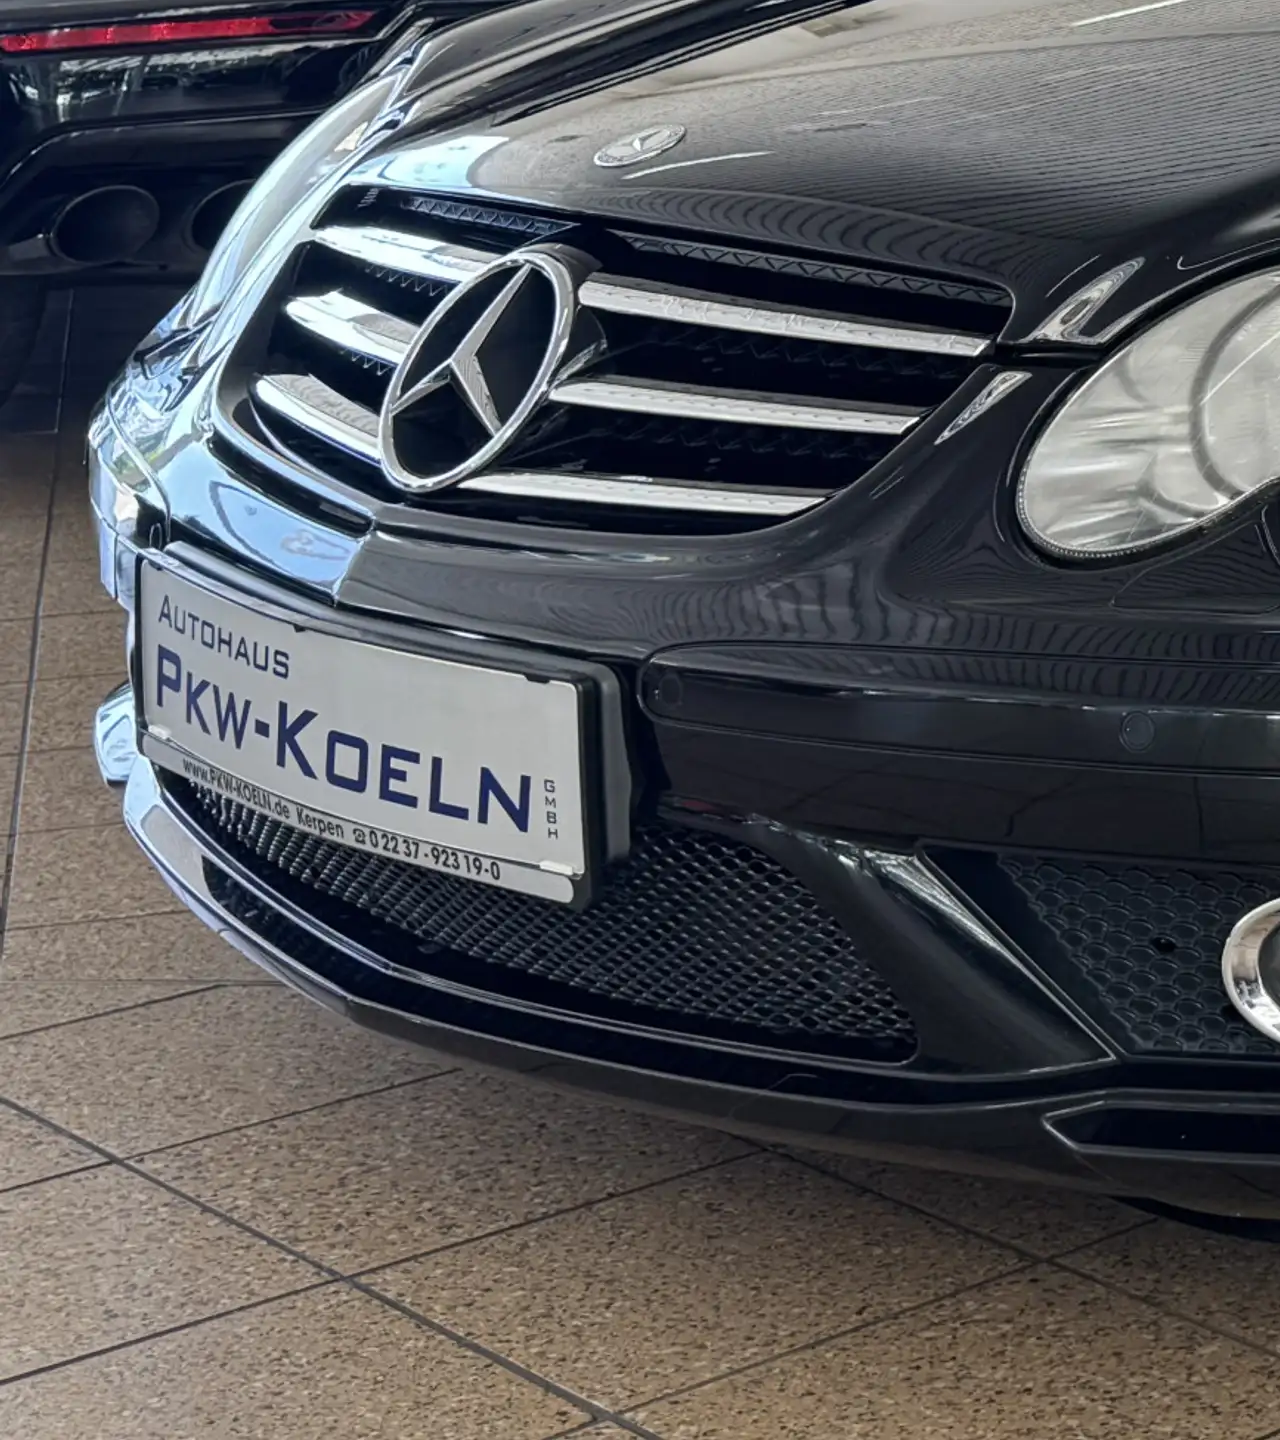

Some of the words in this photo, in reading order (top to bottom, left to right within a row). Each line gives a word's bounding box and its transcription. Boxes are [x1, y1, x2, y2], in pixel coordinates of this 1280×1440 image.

[157, 594, 291, 680] AUTOHAUS
[156, 645, 532, 834] PKW-KOELN
[296, 807, 345, 839] Kerpen
